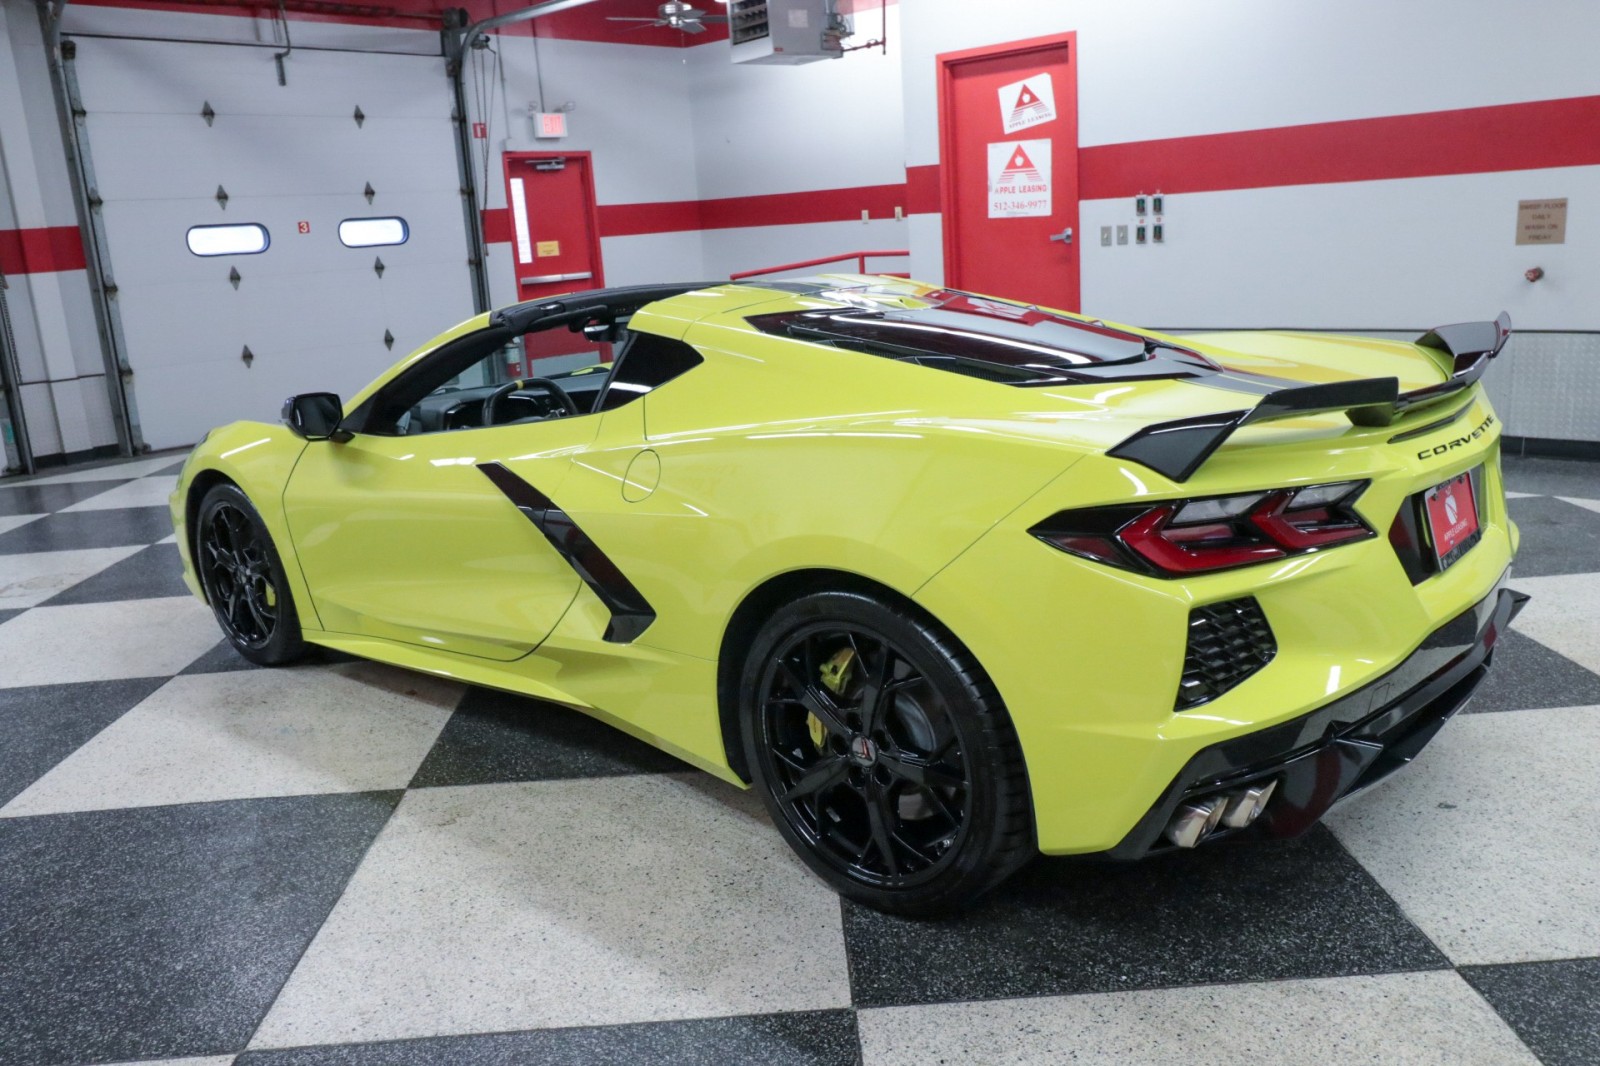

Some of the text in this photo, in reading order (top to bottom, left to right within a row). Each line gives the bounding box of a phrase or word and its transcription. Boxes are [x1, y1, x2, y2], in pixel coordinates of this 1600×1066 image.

[994, 184, 1048, 195] APPLE LEASING
[993, 200, 1048, 212] 512-346-9977
[300, 222, 308, 233] 3
[1417, 414, 1494, 460] CORVETTE
